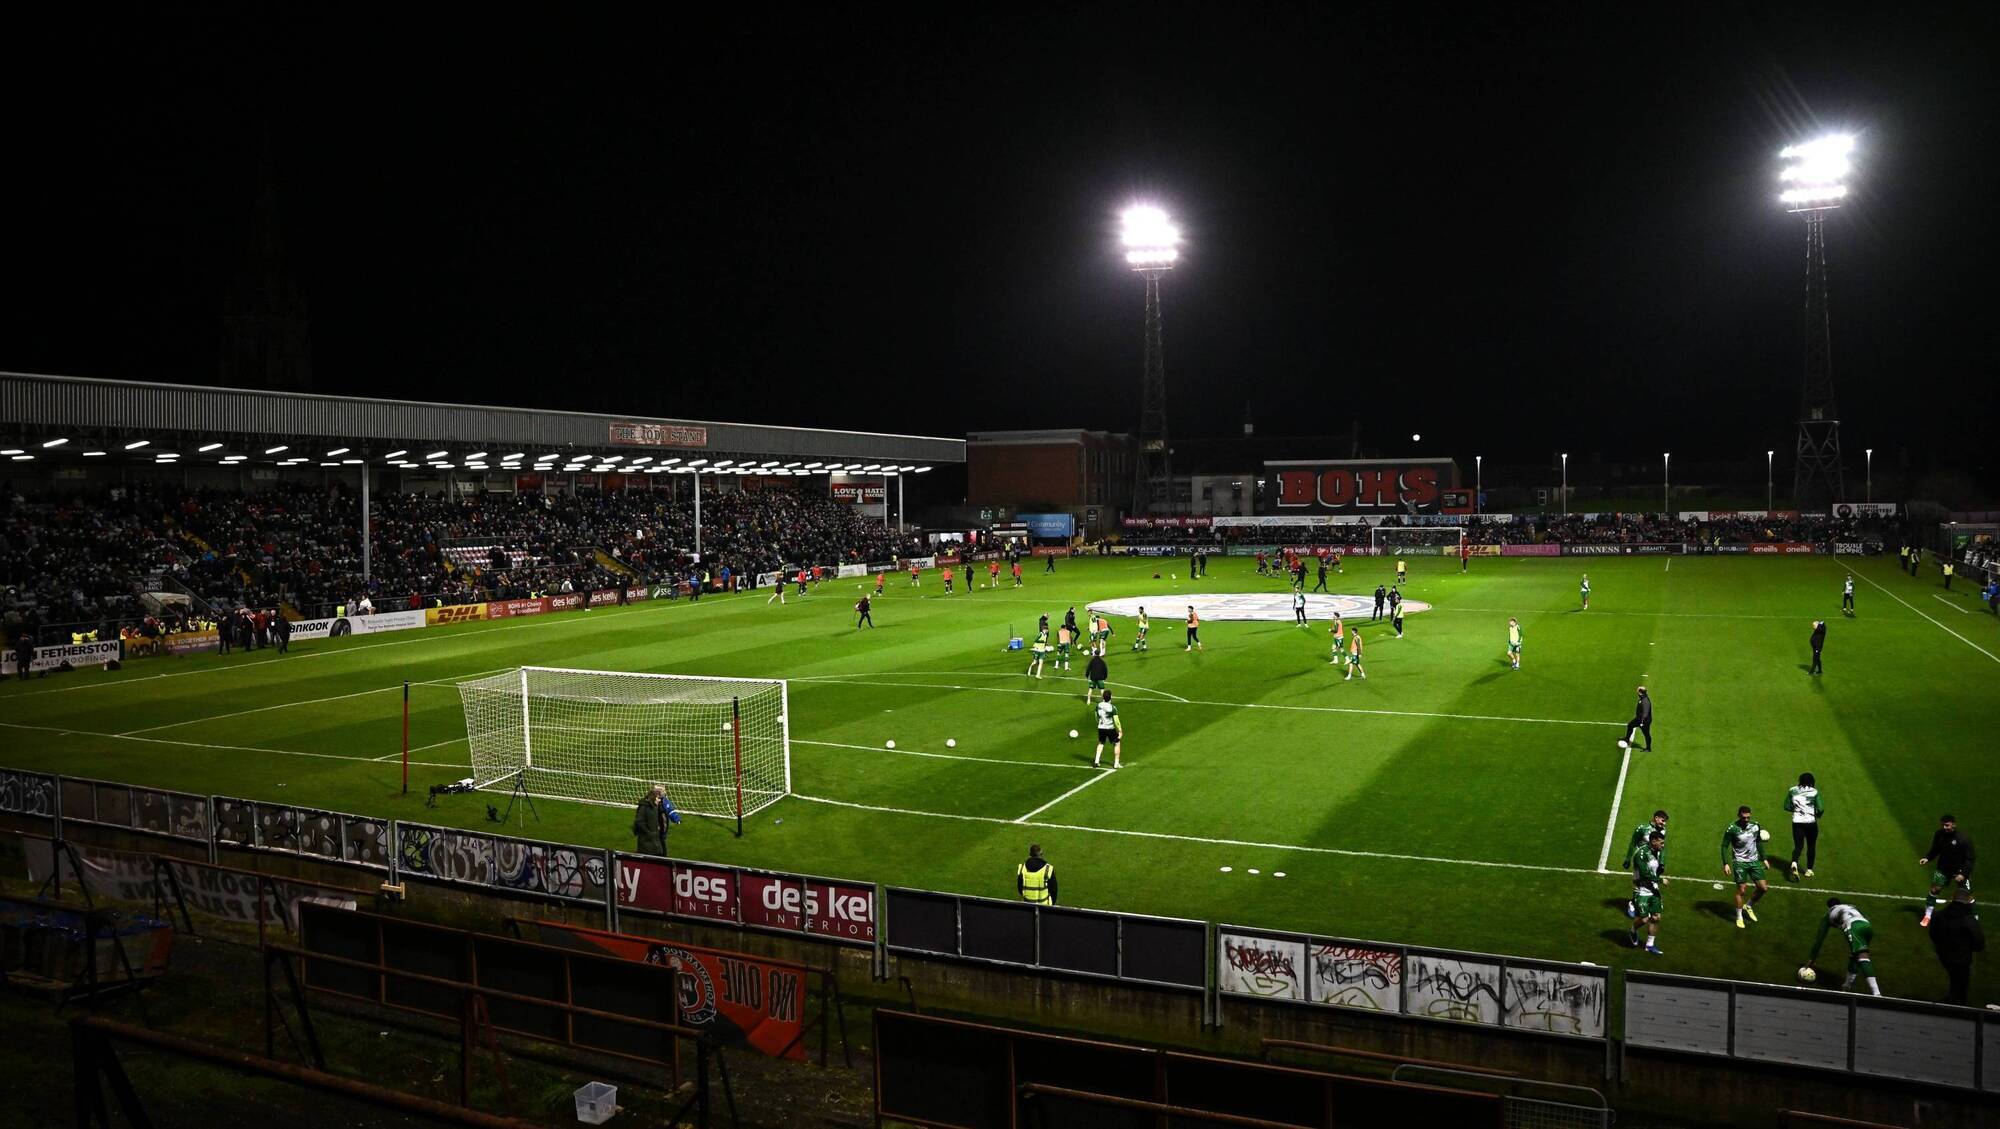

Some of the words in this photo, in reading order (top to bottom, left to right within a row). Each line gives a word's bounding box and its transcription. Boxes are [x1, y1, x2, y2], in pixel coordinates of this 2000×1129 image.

[615, 427, 636, 439] THE
[640, 428, 665, 441] JODI
[671, 430, 703, 442] STAND
[833, 487, 857, 495] LOVE
[1276, 468, 1438, 508] BOHS
[1125, 517, 1136, 525] des
[1166, 517, 1180, 526] kelly
[1185, 517, 1196, 525] des
[1196, 517, 1211, 526] kelly
[1295, 546, 1311, 555] kelly
[1571, 545, 1620, 553] GUINNESS
[552, 598, 566, 607] des
[566, 595, 583, 606] kelly
[602, 591, 618, 603] kelly
[436, 606, 482, 623] DHL
[41, 642, 118, 659] FETHERSTON
[676, 868, 727, 903] des
[762, 879, 819, 916] des
[766, 912, 874, 937] INTERIOR
